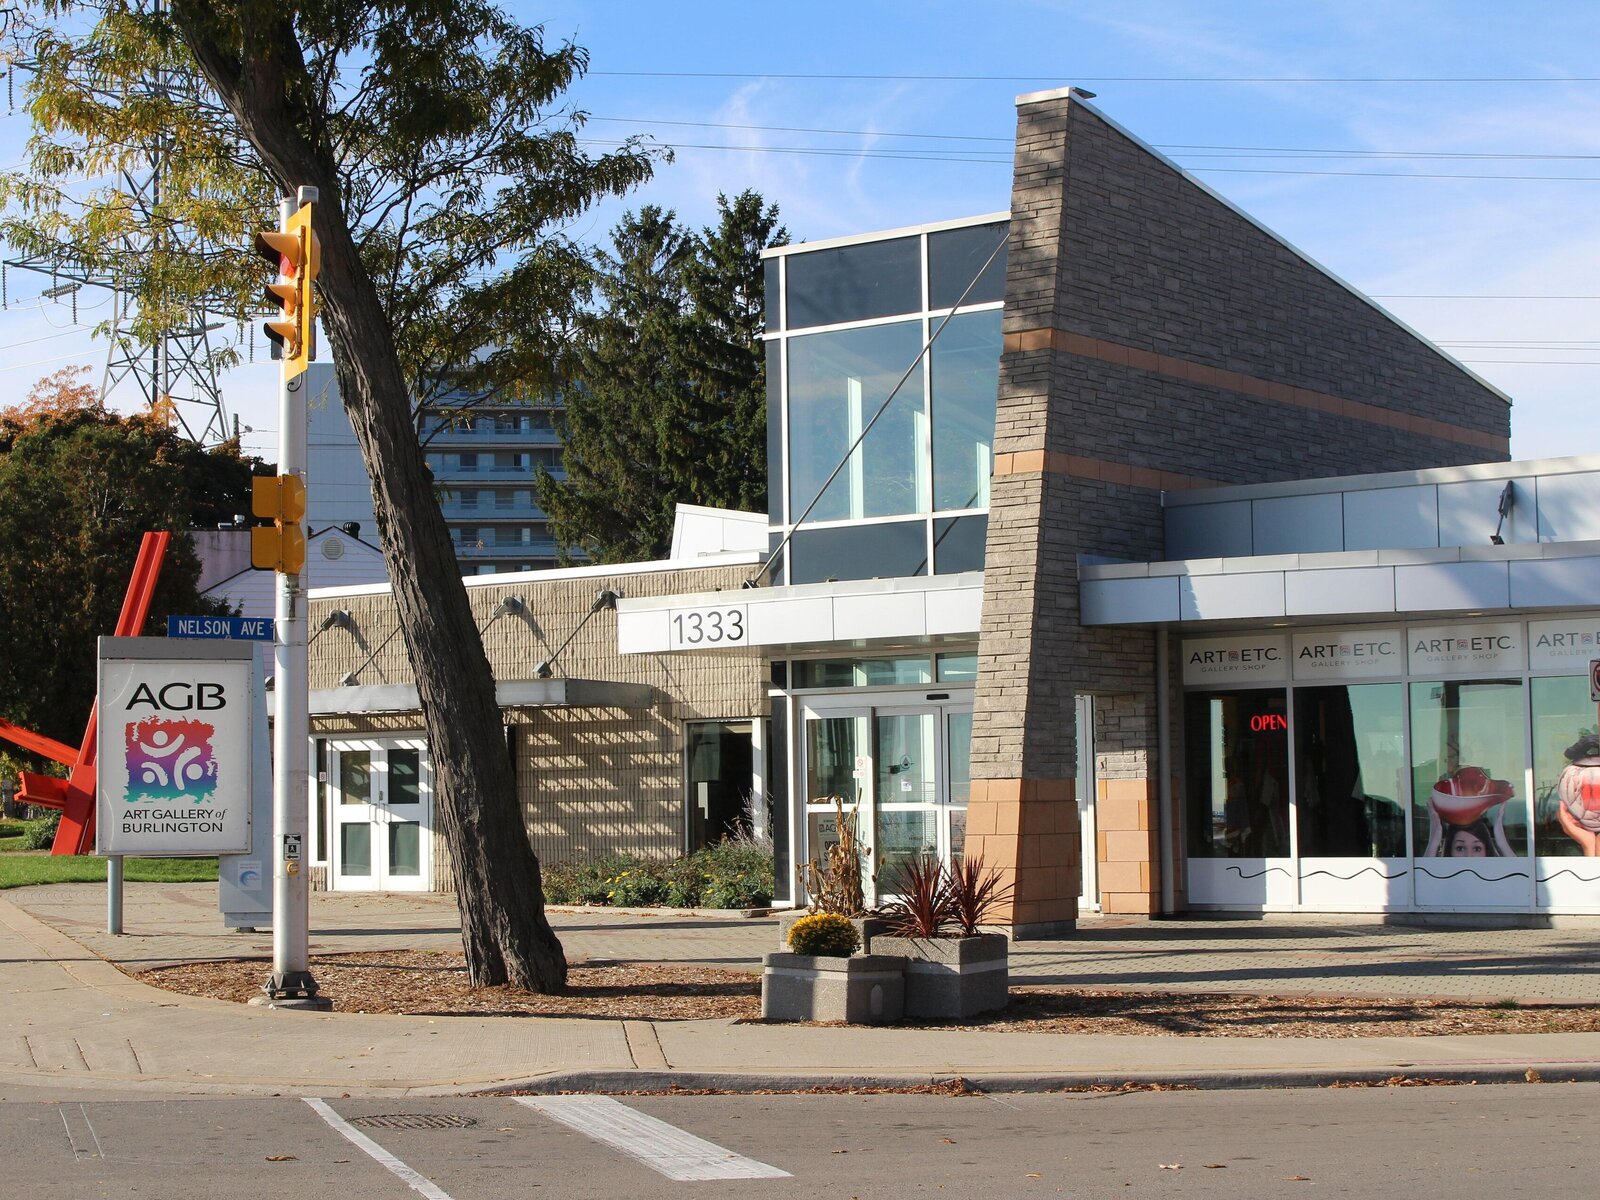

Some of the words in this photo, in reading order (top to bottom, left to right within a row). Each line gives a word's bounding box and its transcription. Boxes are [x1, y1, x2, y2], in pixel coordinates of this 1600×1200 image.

[178, 619, 231, 635] NELSON
[240, 621, 265, 636] AVE
[673, 609, 744, 644] 1333
[1414, 638, 1455, 654] ART
[1471, 635, 1516, 651] ETC.
[1535, 632, 1579, 648] ART
[1189, 650, 1227, 665] ART
[1241, 647, 1282, 662] ETC.
[1299, 644, 1339, 659] ART
[1353, 641, 1396, 657] ETC.
[1426, 653, 1468, 663] GALLERY
[1472, 652, 1499, 661] SHOP
[1201, 665, 1239, 673] GALLERY
[1243, 663, 1267, 671] SHOP
[1311, 660, 1351, 668] GALLERY
[1354, 658, 1380, 667] SHOP
[125, 682, 227, 711] AGB
[1250, 714, 1287, 732] OPEN
[123, 809, 150, 820] ART
[151, 809, 214, 820] GALLERY
[215, 808, 228, 821] of
[122, 822, 223, 833] BURLINGTON
